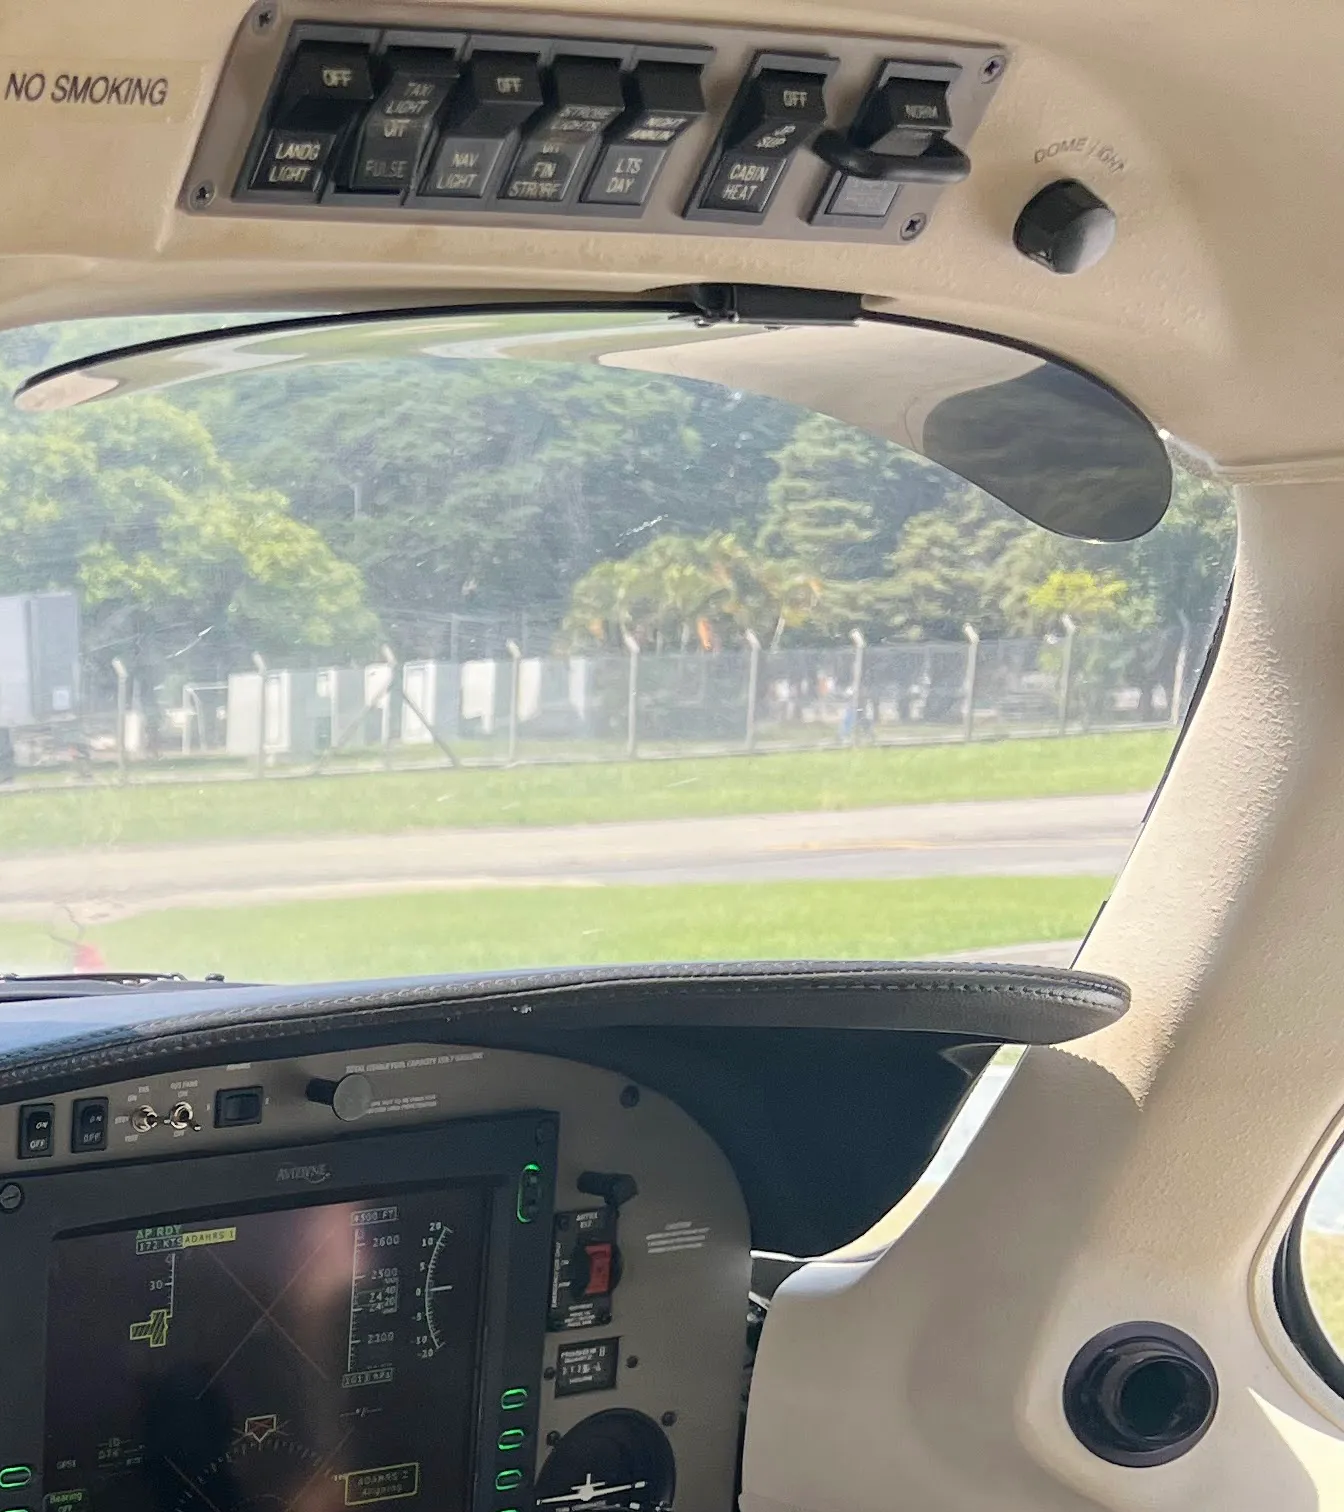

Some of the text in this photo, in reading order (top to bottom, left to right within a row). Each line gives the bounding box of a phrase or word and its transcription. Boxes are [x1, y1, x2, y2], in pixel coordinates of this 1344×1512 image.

[322, 68, 353, 89] OFF
[4, 72, 169, 106] NO SMOKING
[782, 90, 808, 108] OFF
[275, 143, 320, 162] LANDG
[452, 151, 478, 168] NAV
[1033, 136, 1087, 165] DOME
[269, 165, 311, 184] LIGHT
[365, 159, 407, 178] PULSE
[614, 157, 641, 175] LTS
[728, 163, 770, 182] CABIN
[436, 172, 478, 191] LIGHT
[606, 176, 634, 194] DAY
[722, 183, 758, 201] HEAT
[156, 1225, 182, 1236] RDY
[185, 1230, 224, 1243] ADAHRS
[150, 1280, 163, 1290] 30
